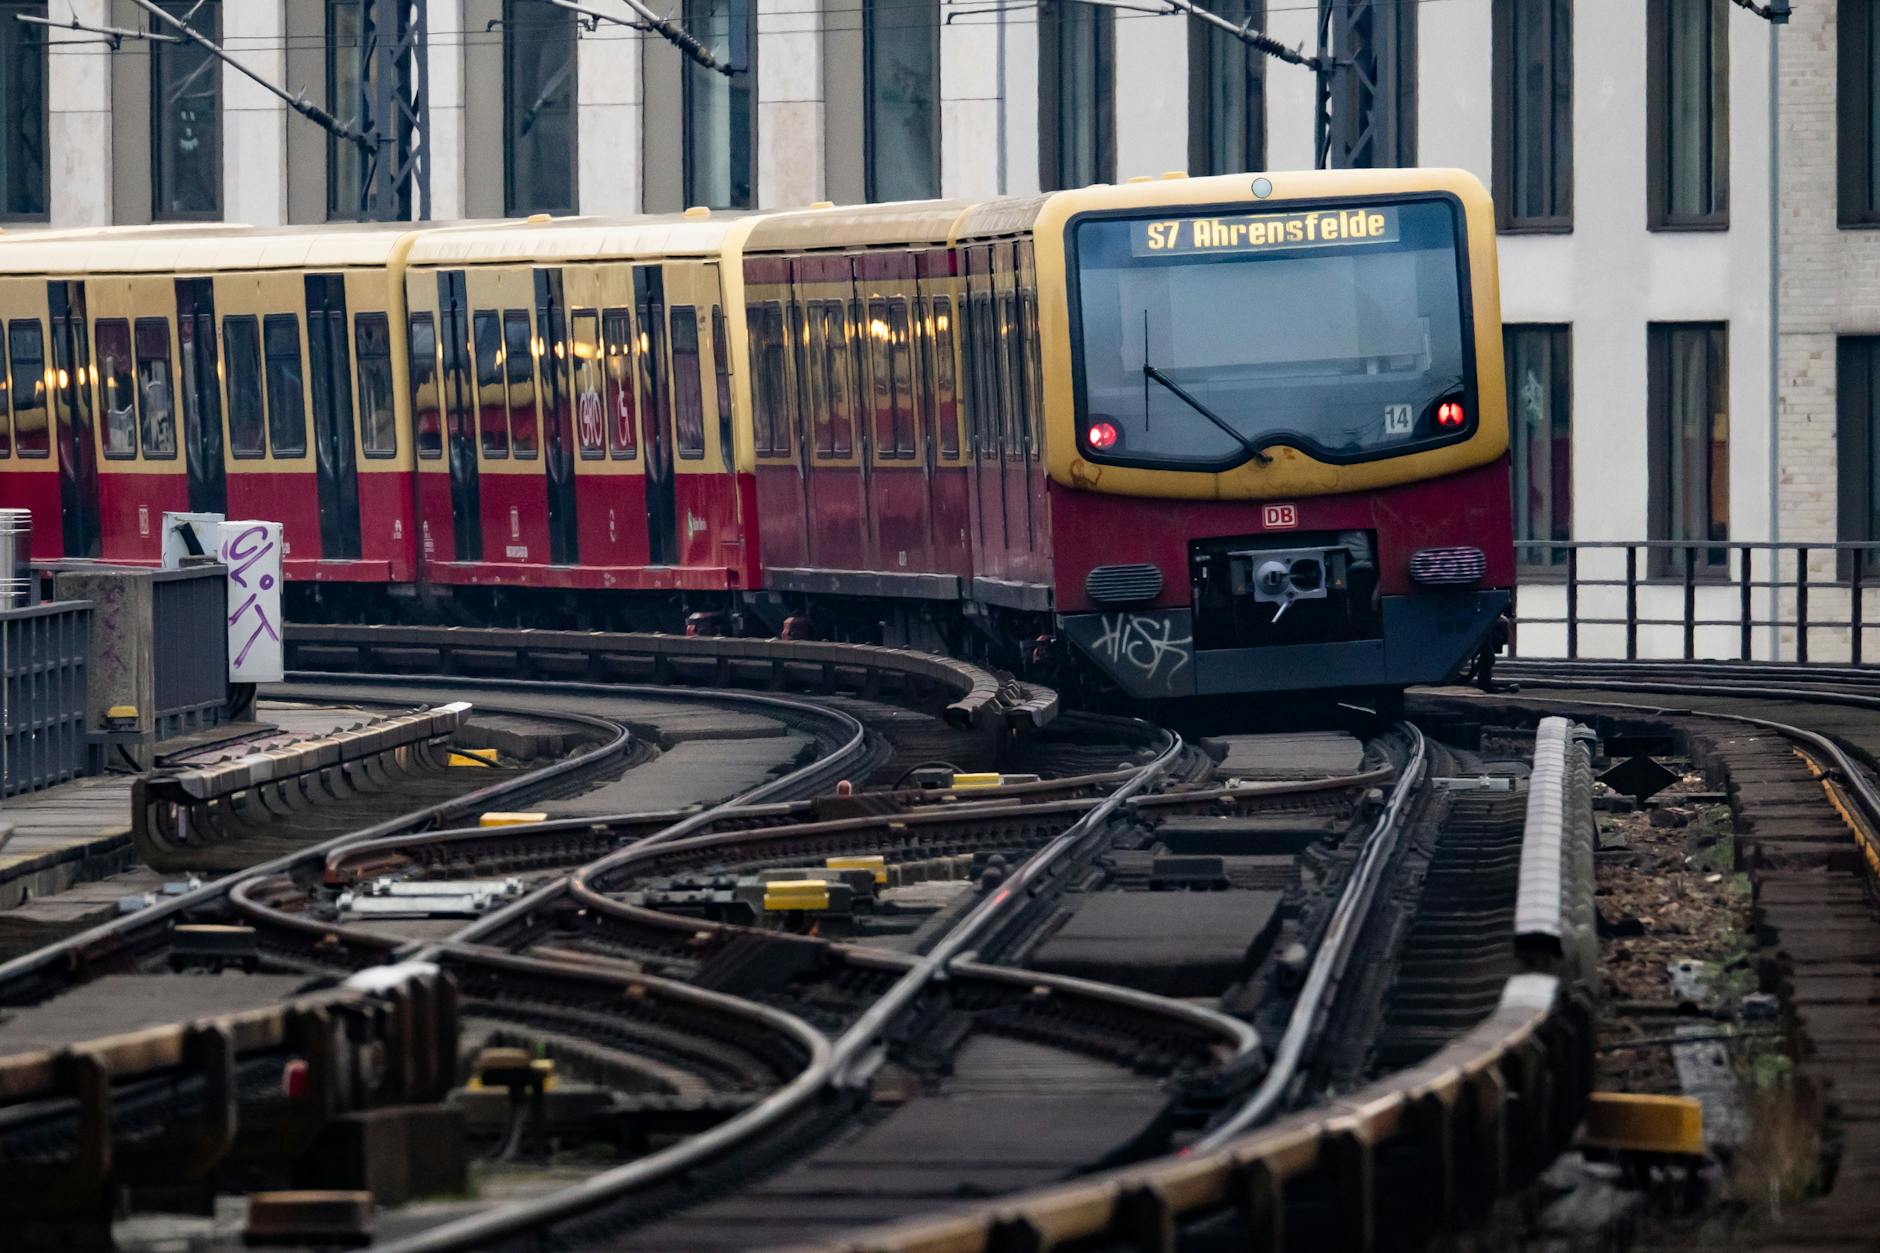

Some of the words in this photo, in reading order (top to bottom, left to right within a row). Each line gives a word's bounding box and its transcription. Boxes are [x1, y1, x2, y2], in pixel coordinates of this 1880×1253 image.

[1147, 220, 1180, 249] S7
[1193, 210, 1385, 247] Ahrensfelde
[1385, 407, 1409, 430] 14
[1266, 506, 1294, 524] DB
